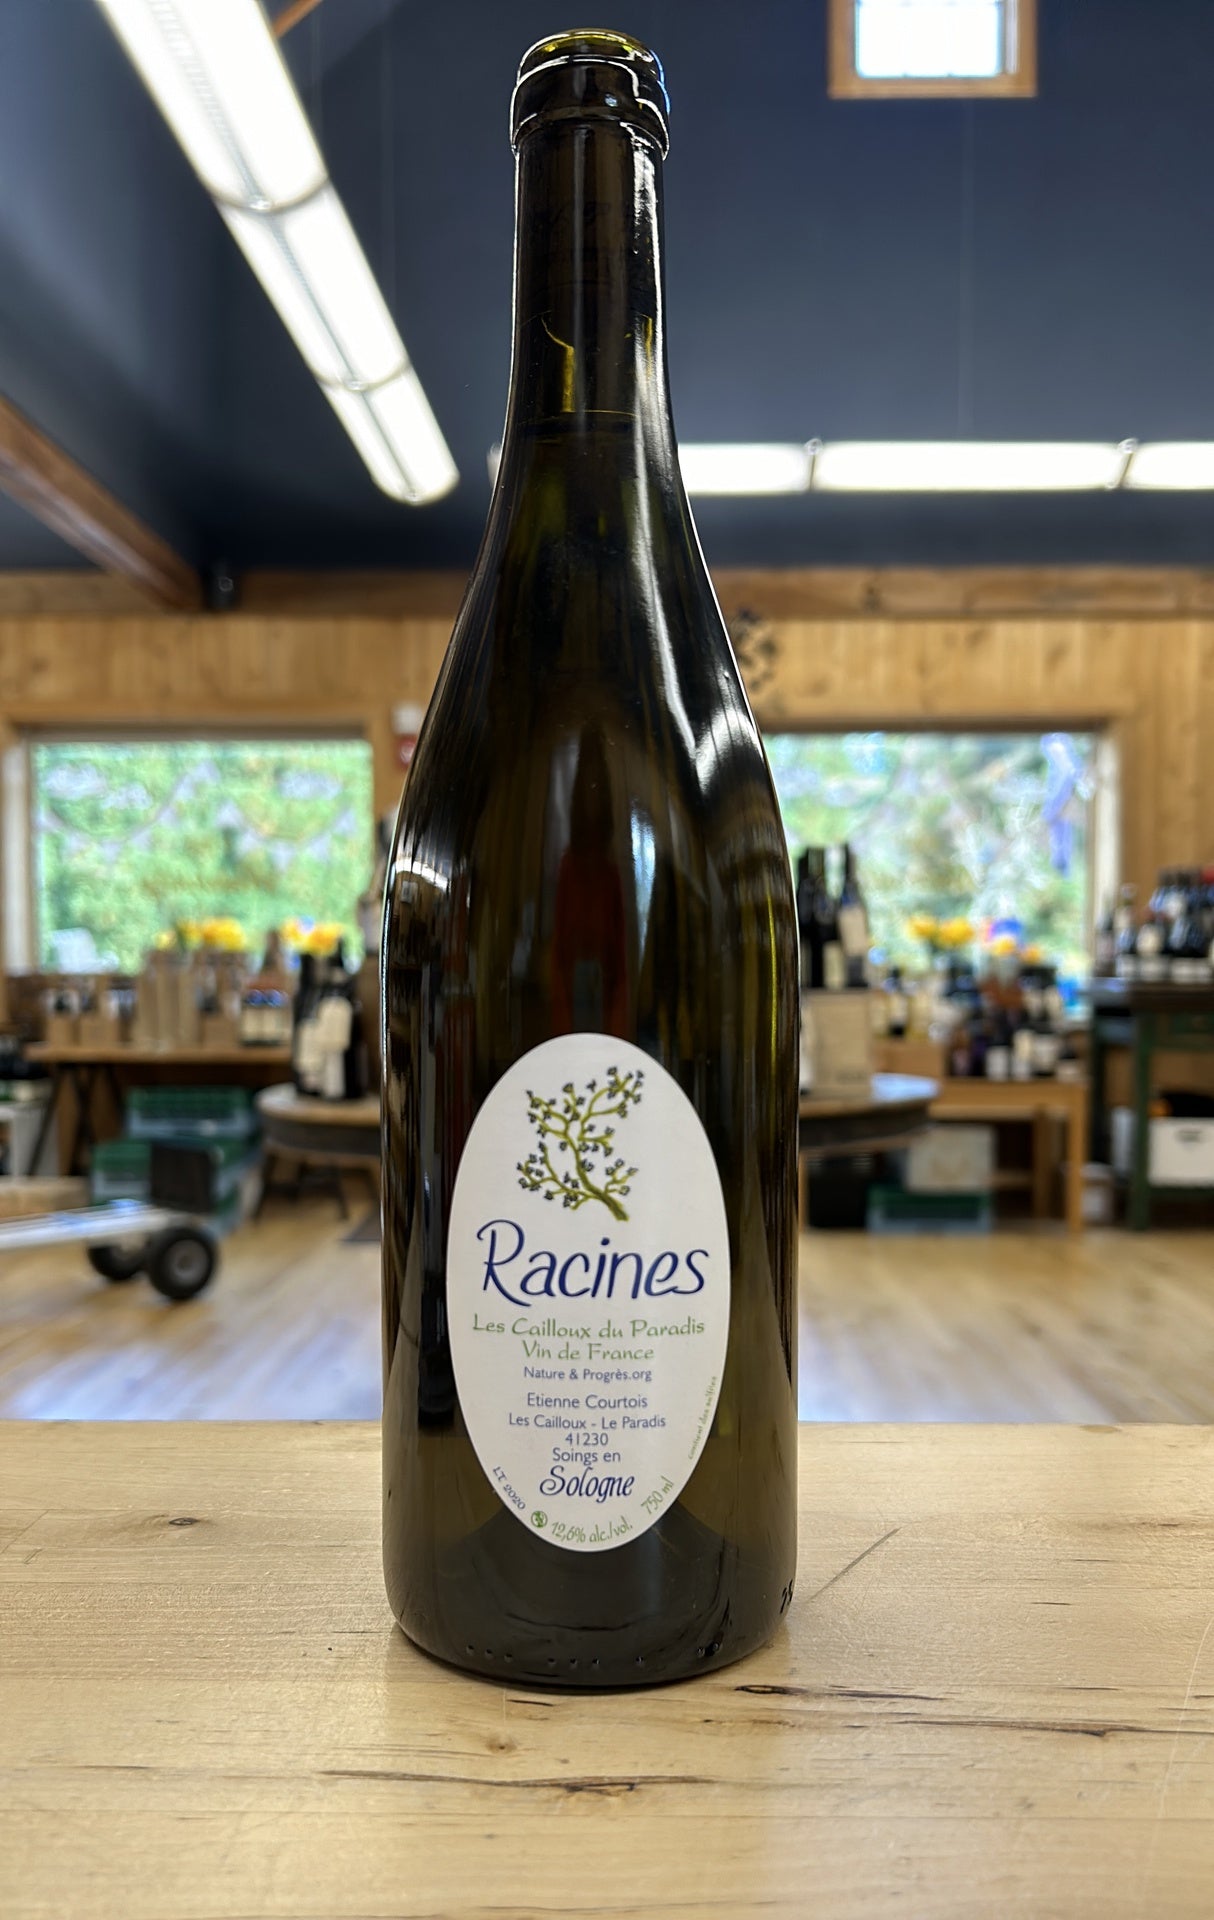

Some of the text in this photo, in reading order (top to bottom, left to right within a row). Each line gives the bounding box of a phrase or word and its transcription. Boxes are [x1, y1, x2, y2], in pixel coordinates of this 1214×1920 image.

[475, 1219, 710, 1307] Racines
[473, 1313, 704, 1339] Les Cailloux du Paradis
[522, 1340, 653, 1360] Vin de France
[524, 1366, 652, 1383] Nature & Progrès.org
[528, 1392, 647, 1409] Etienne Courtois
[509, 1413, 529, 1426] Les
[534, 1415, 586, 1429] Cailloux
[602, 1417, 617, 1429] Le
[623, 1416, 666, 1429] Paradis
[565, 1433, 608, 1446] 41230
[552, 1448, 621, 1465] Soings en
[539, 1465, 636, 1503] Sologne
[503, 1483, 526, 1511] 2020
[640, 1475, 675, 1516] 750 ml
[551, 1521, 586, 1544] 12,6%
